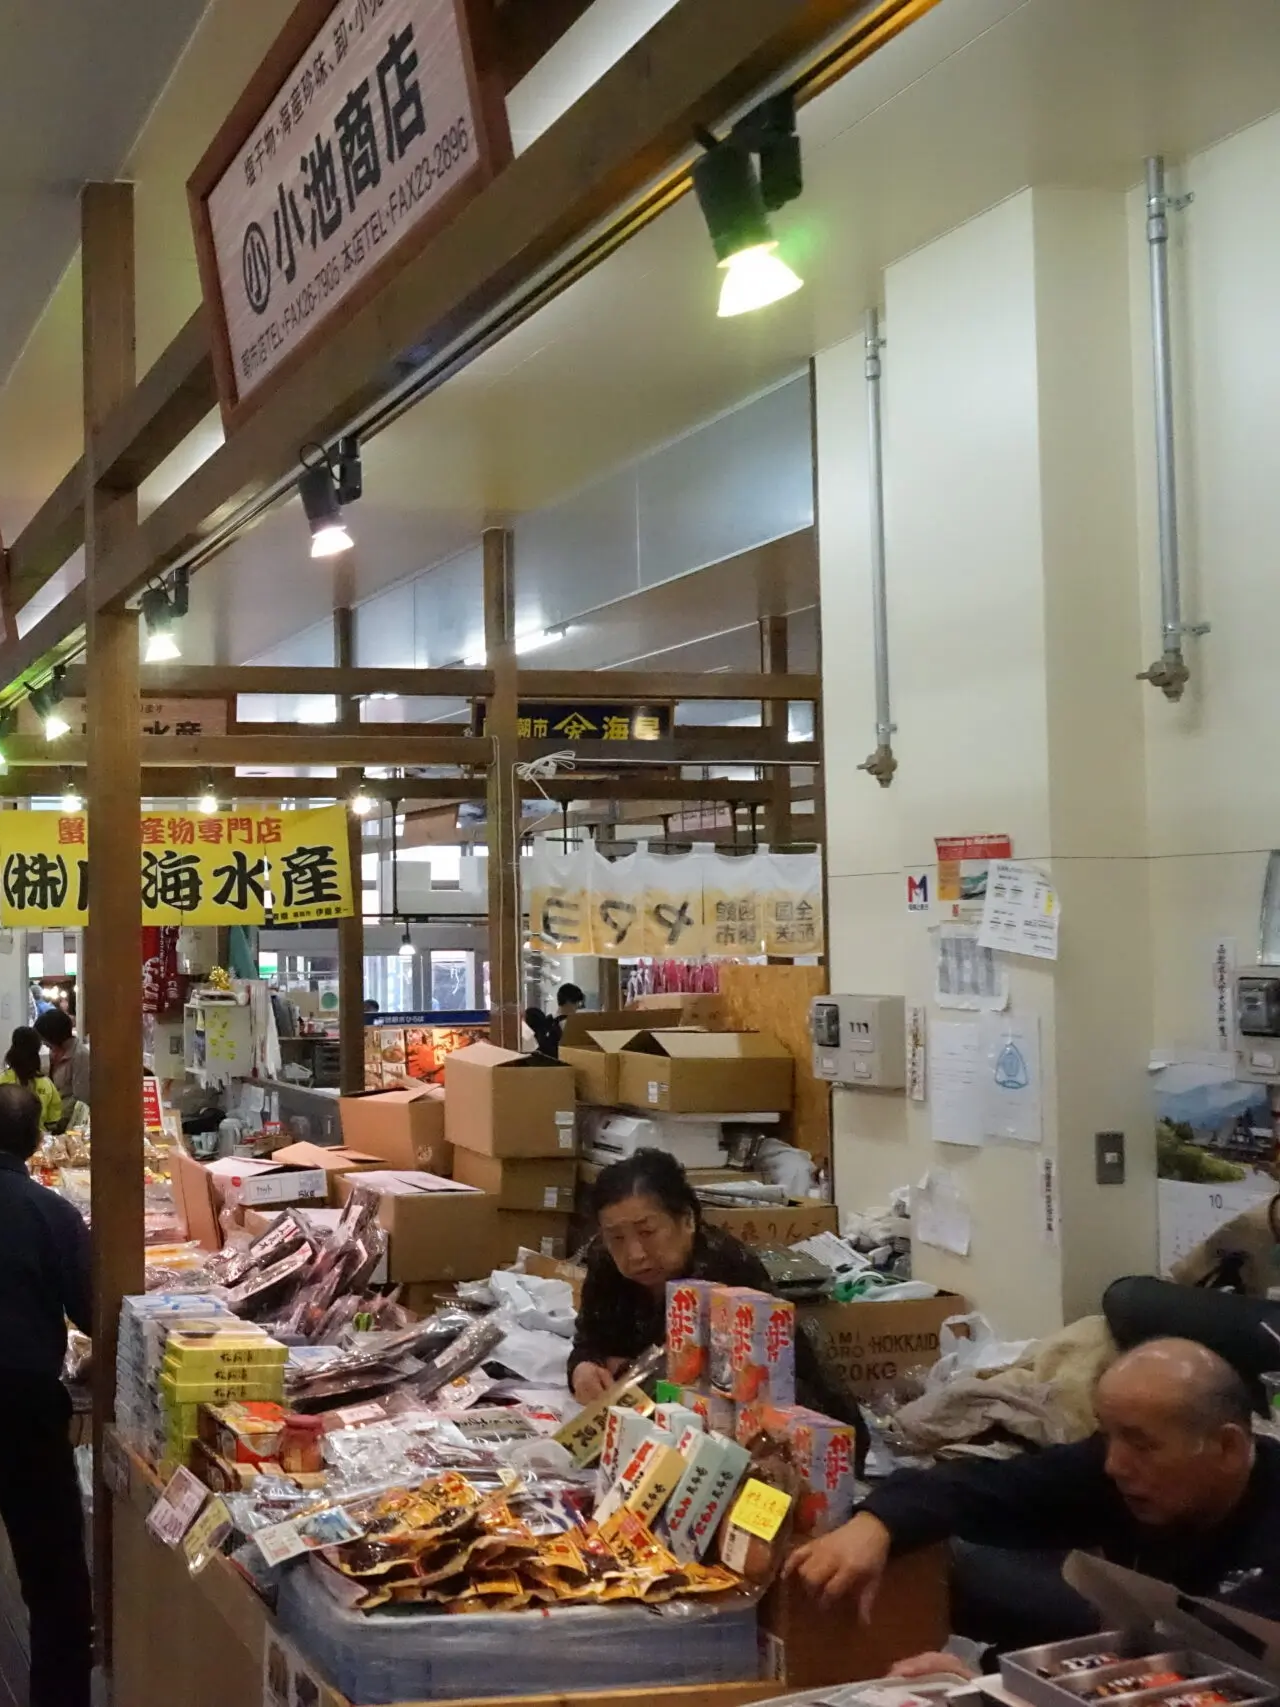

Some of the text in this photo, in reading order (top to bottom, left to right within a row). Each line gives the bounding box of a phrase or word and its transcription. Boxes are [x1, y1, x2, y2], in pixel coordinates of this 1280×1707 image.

[274, 21, 427, 285] 小池商店
[58, 816, 284, 845] 蟹産物専門店
[3, 846, 342, 910] (株)海水産
[1208, 1194, 1223, 1209] 10
[871, 1332, 941, 1354] HOKKAID
